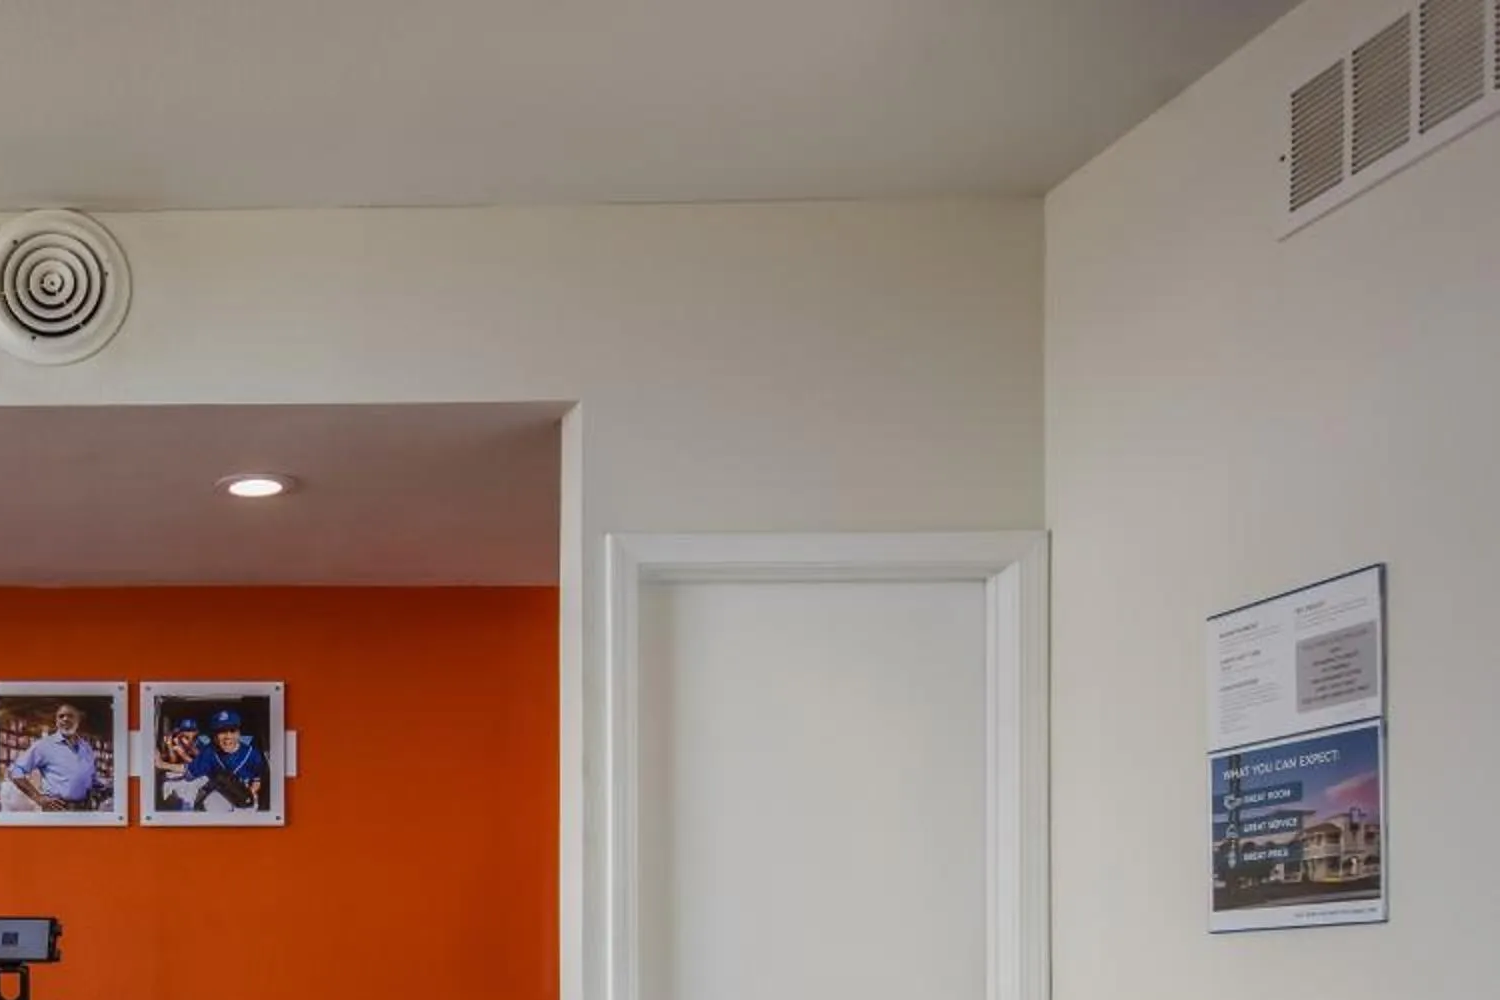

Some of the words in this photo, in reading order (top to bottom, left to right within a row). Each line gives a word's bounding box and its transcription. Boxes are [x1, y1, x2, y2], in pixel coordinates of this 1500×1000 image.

[1223, 767, 1250, 780] WHAT
[1253, 763, 1273, 776] YOU
[1275, 758, 1297, 771] CAN
